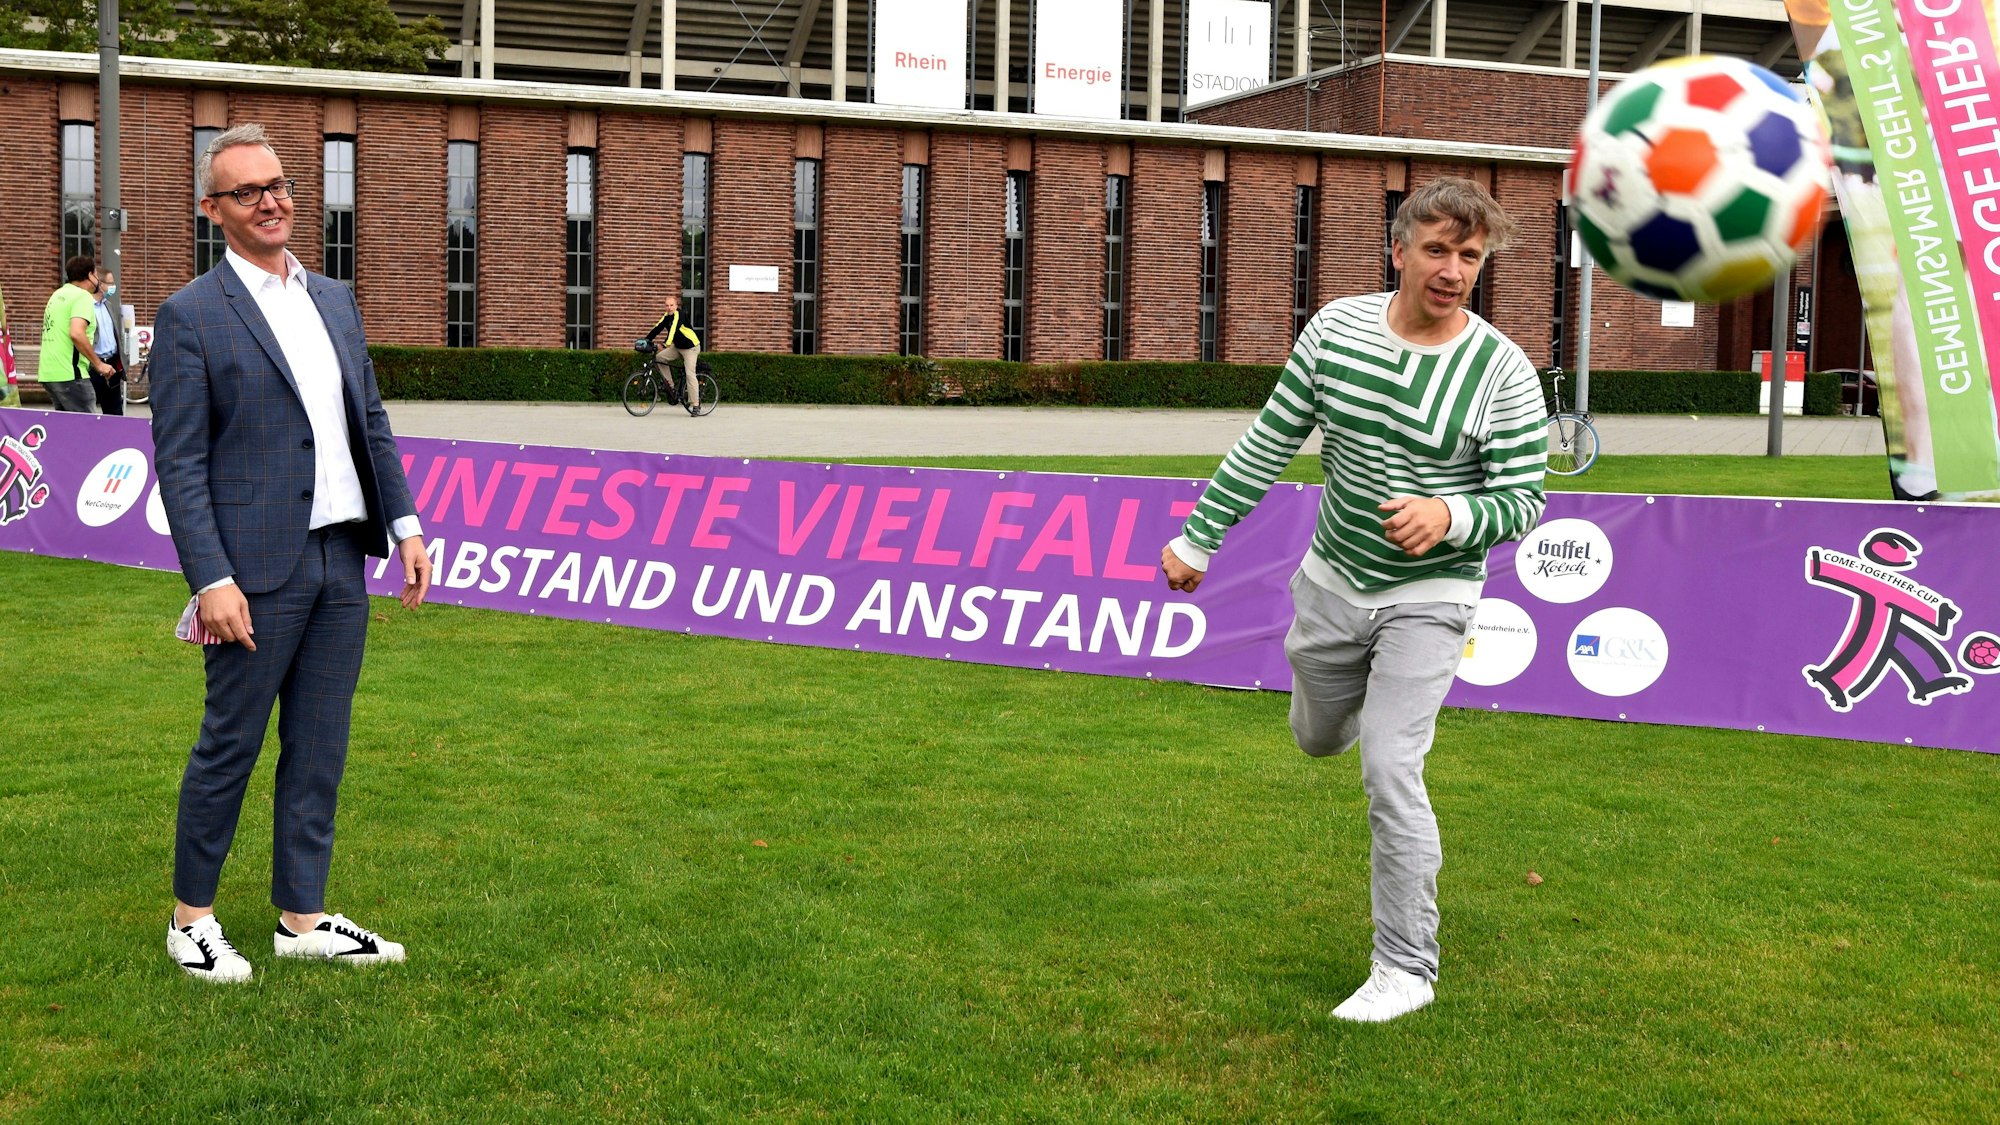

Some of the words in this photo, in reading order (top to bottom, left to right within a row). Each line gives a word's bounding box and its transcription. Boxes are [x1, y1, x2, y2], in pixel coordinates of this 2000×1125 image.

[894, 51, 947, 71] Rhein
[1045, 62, 1112, 85] Energie
[1192, 73, 1264, 92] STADION
[85, 500, 122, 511] NetCologne
[401, 454, 752, 550] UNTESTE
[778, 480, 1198, 582] VIELFAL
[1537, 539, 1591, 560] Gaffel
[1533, 560, 1588, 577] Kölsch
[1823, 552, 1939, 605] COME-TOGETHER-CUP
[426, 537, 676, 610] ABSTAND
[691, 565, 836, 626] UND
[846, 579, 1207, 658] ANSTAND
[1477, 624, 1516, 633] Nordrhein
[1575, 645, 1595, 655] AXA
